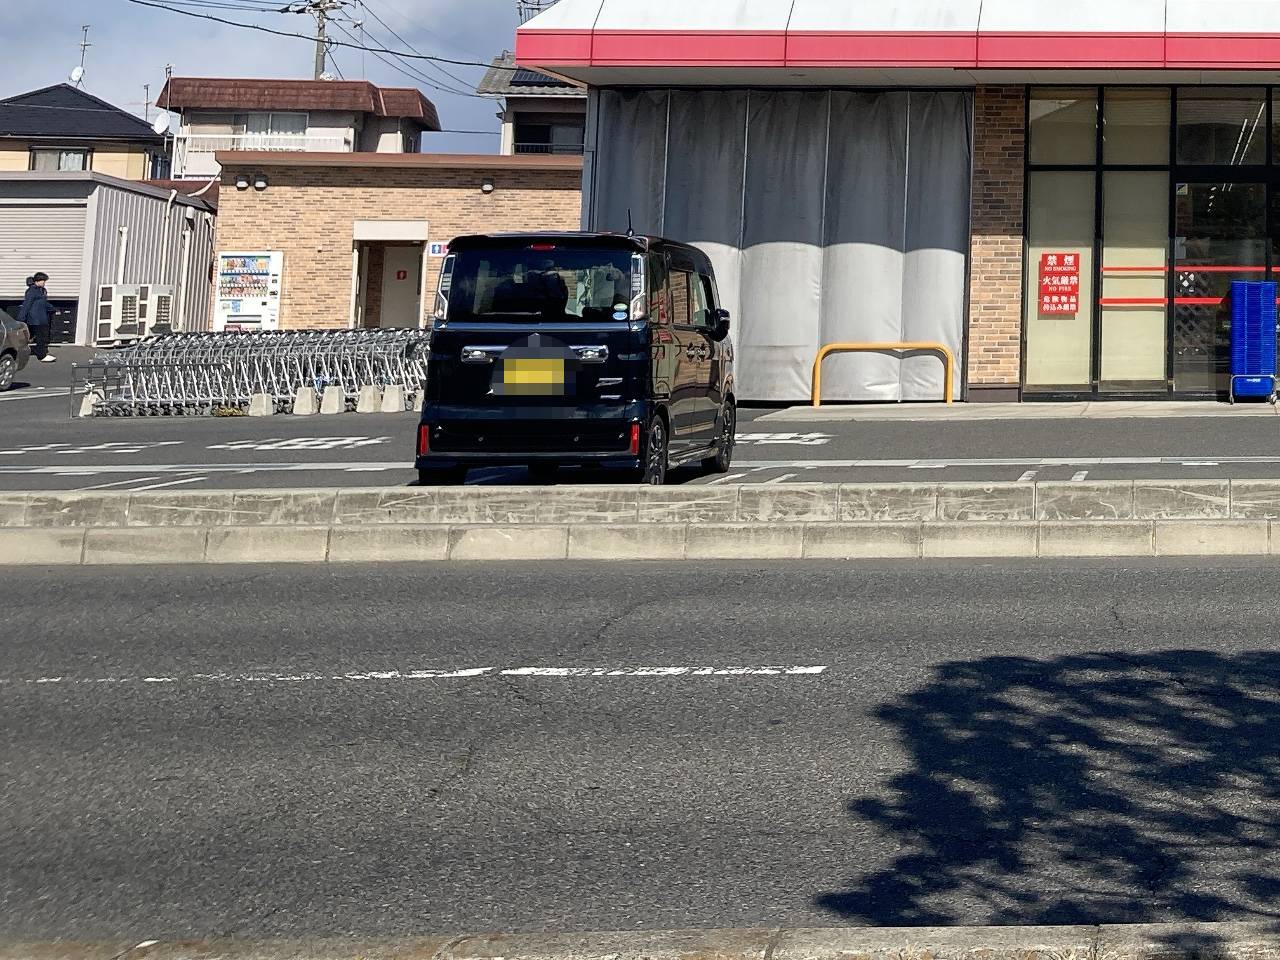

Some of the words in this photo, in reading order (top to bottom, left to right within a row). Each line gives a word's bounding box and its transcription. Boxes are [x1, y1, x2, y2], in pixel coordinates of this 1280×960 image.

[1047, 254, 1075, 266] 禁煙
[1042, 275, 1078, 285] 火気厳禁
